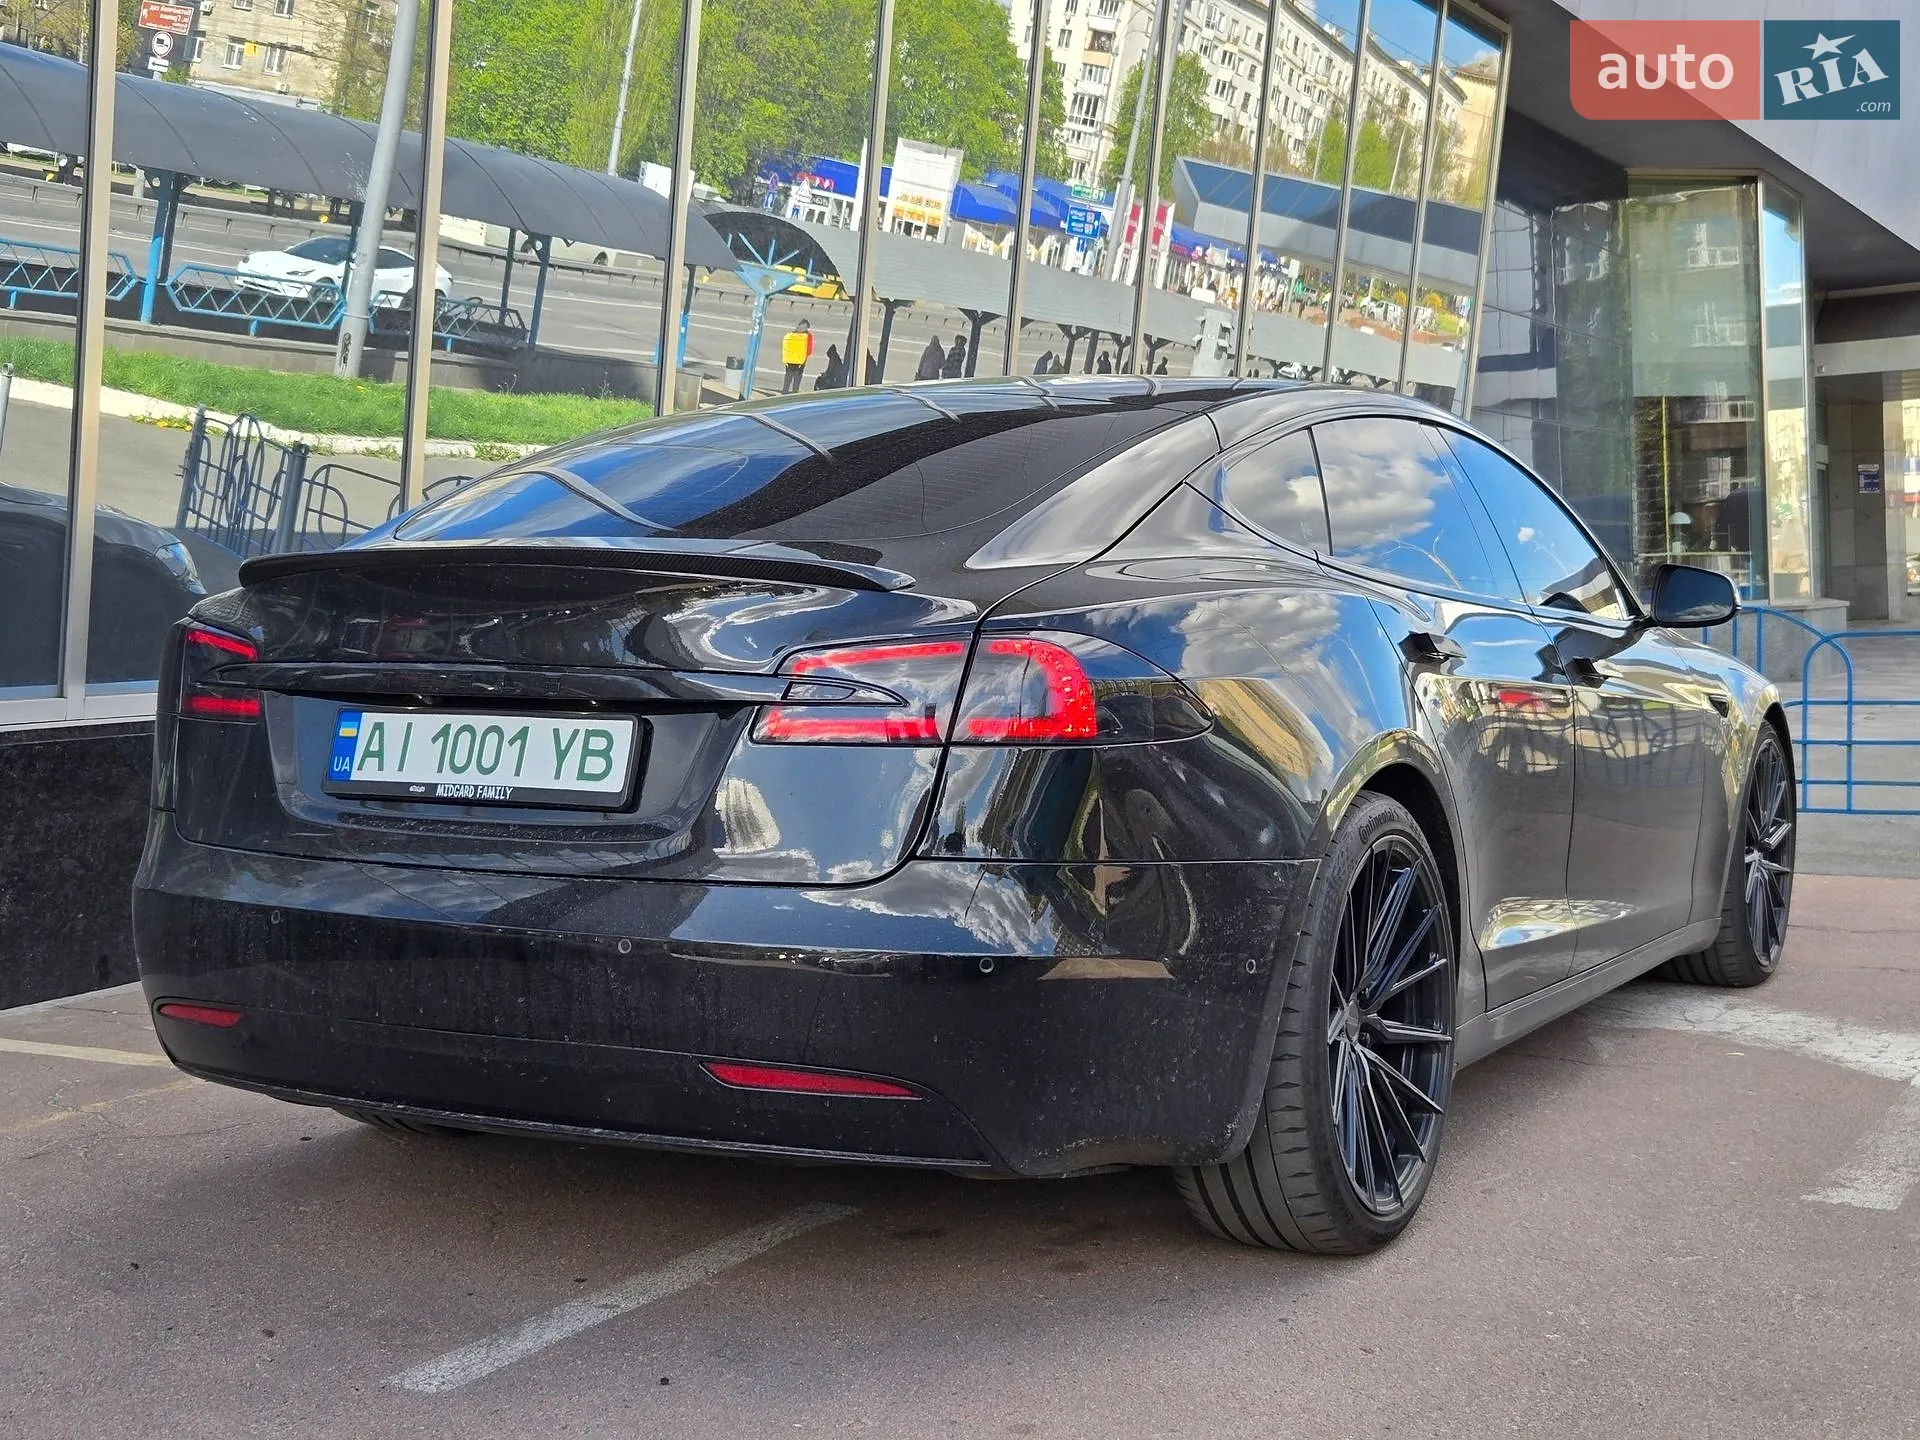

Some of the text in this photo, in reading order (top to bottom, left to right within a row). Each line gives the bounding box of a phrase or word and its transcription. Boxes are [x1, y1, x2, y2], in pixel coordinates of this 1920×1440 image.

[332, 756, 351, 772] UA
[356, 721, 615, 781] AI 1001 YB
[435, 783, 475, 798] MIDGARD
[476, 785, 514, 801] FAMILY
[1358, 807, 1396, 845] Continental
